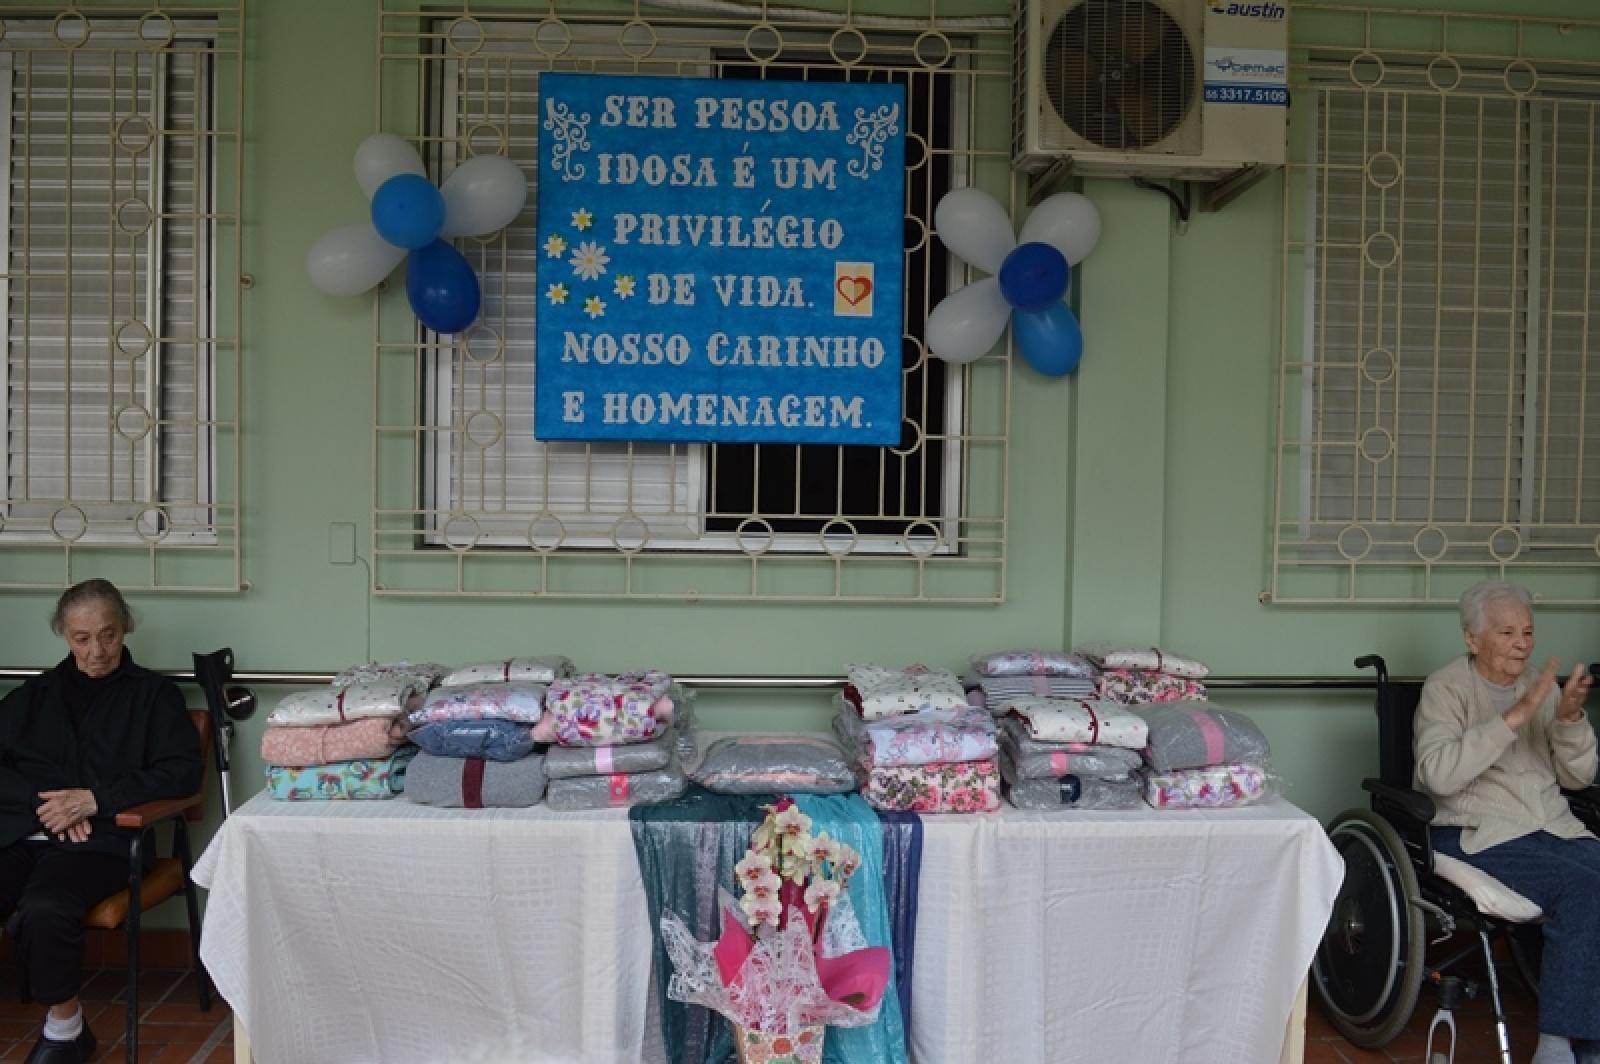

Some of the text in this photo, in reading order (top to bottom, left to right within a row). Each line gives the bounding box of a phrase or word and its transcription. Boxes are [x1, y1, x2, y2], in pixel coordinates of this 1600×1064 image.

[1227, 2, 1285, 18] austin
[601, 95, 840, 132] SER PESSOA
[1219, 88, 1287, 103] 3317.5109
[597, 141, 837, 190] IDOSA É UM
[612, 199, 844, 249] PRIVILÉGIO
[647, 273, 815, 308] DE VIDA.
[561, 331, 885, 369] NOSSO CARINHO
[561, 391, 873, 429] E HOMENAGEM.
